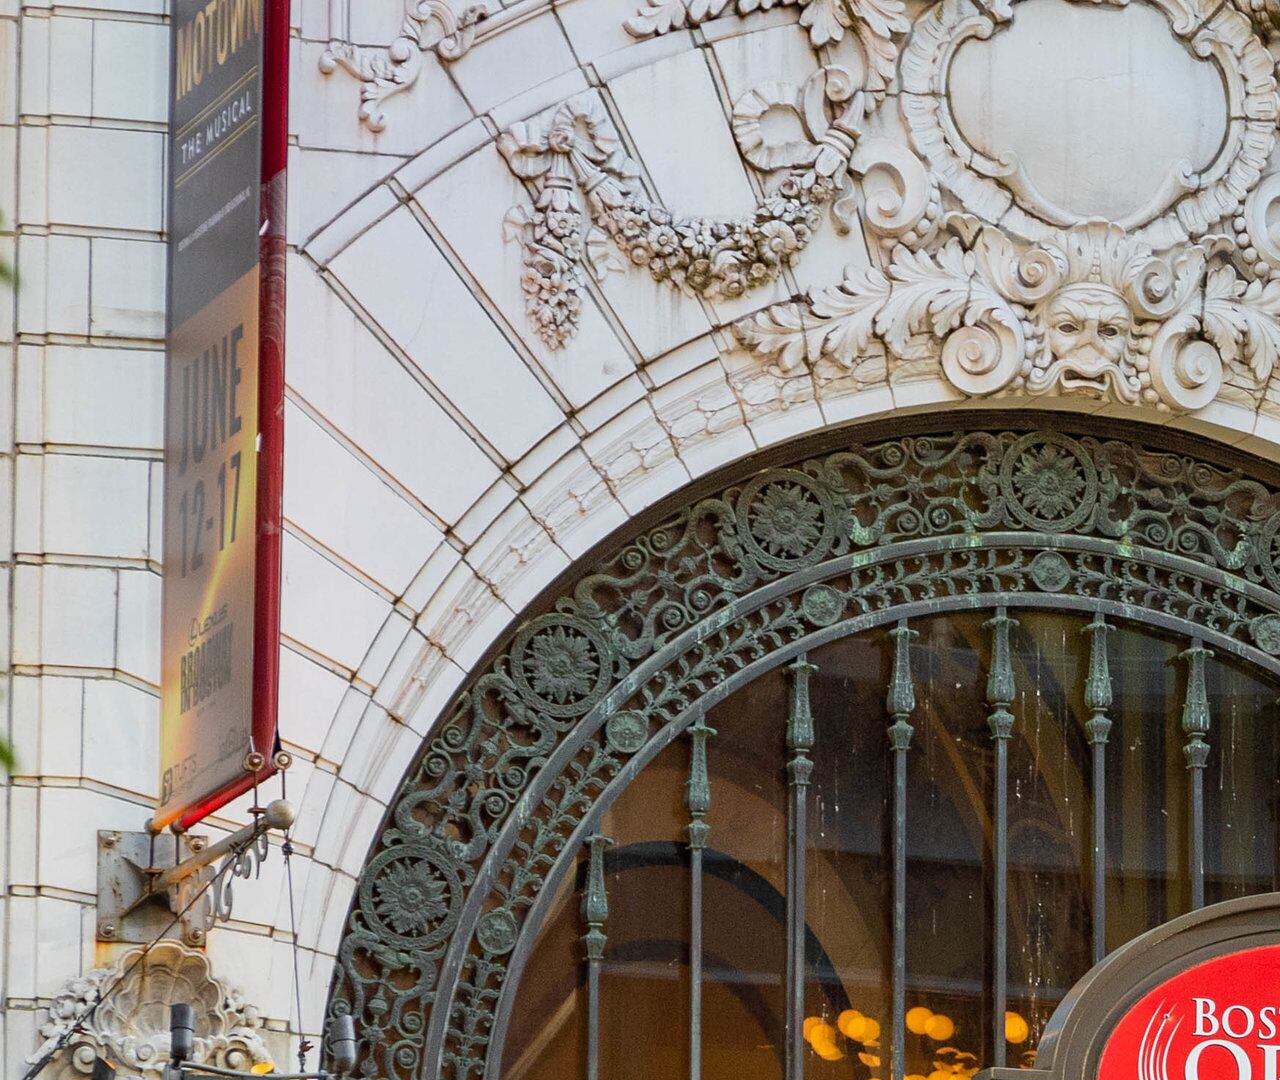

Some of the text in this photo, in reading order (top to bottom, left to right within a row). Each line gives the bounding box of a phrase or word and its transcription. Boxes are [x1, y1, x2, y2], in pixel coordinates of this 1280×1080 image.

[181, 91, 252, 164] THE MUSICAL
[179, 323, 243, 477] JUNE
